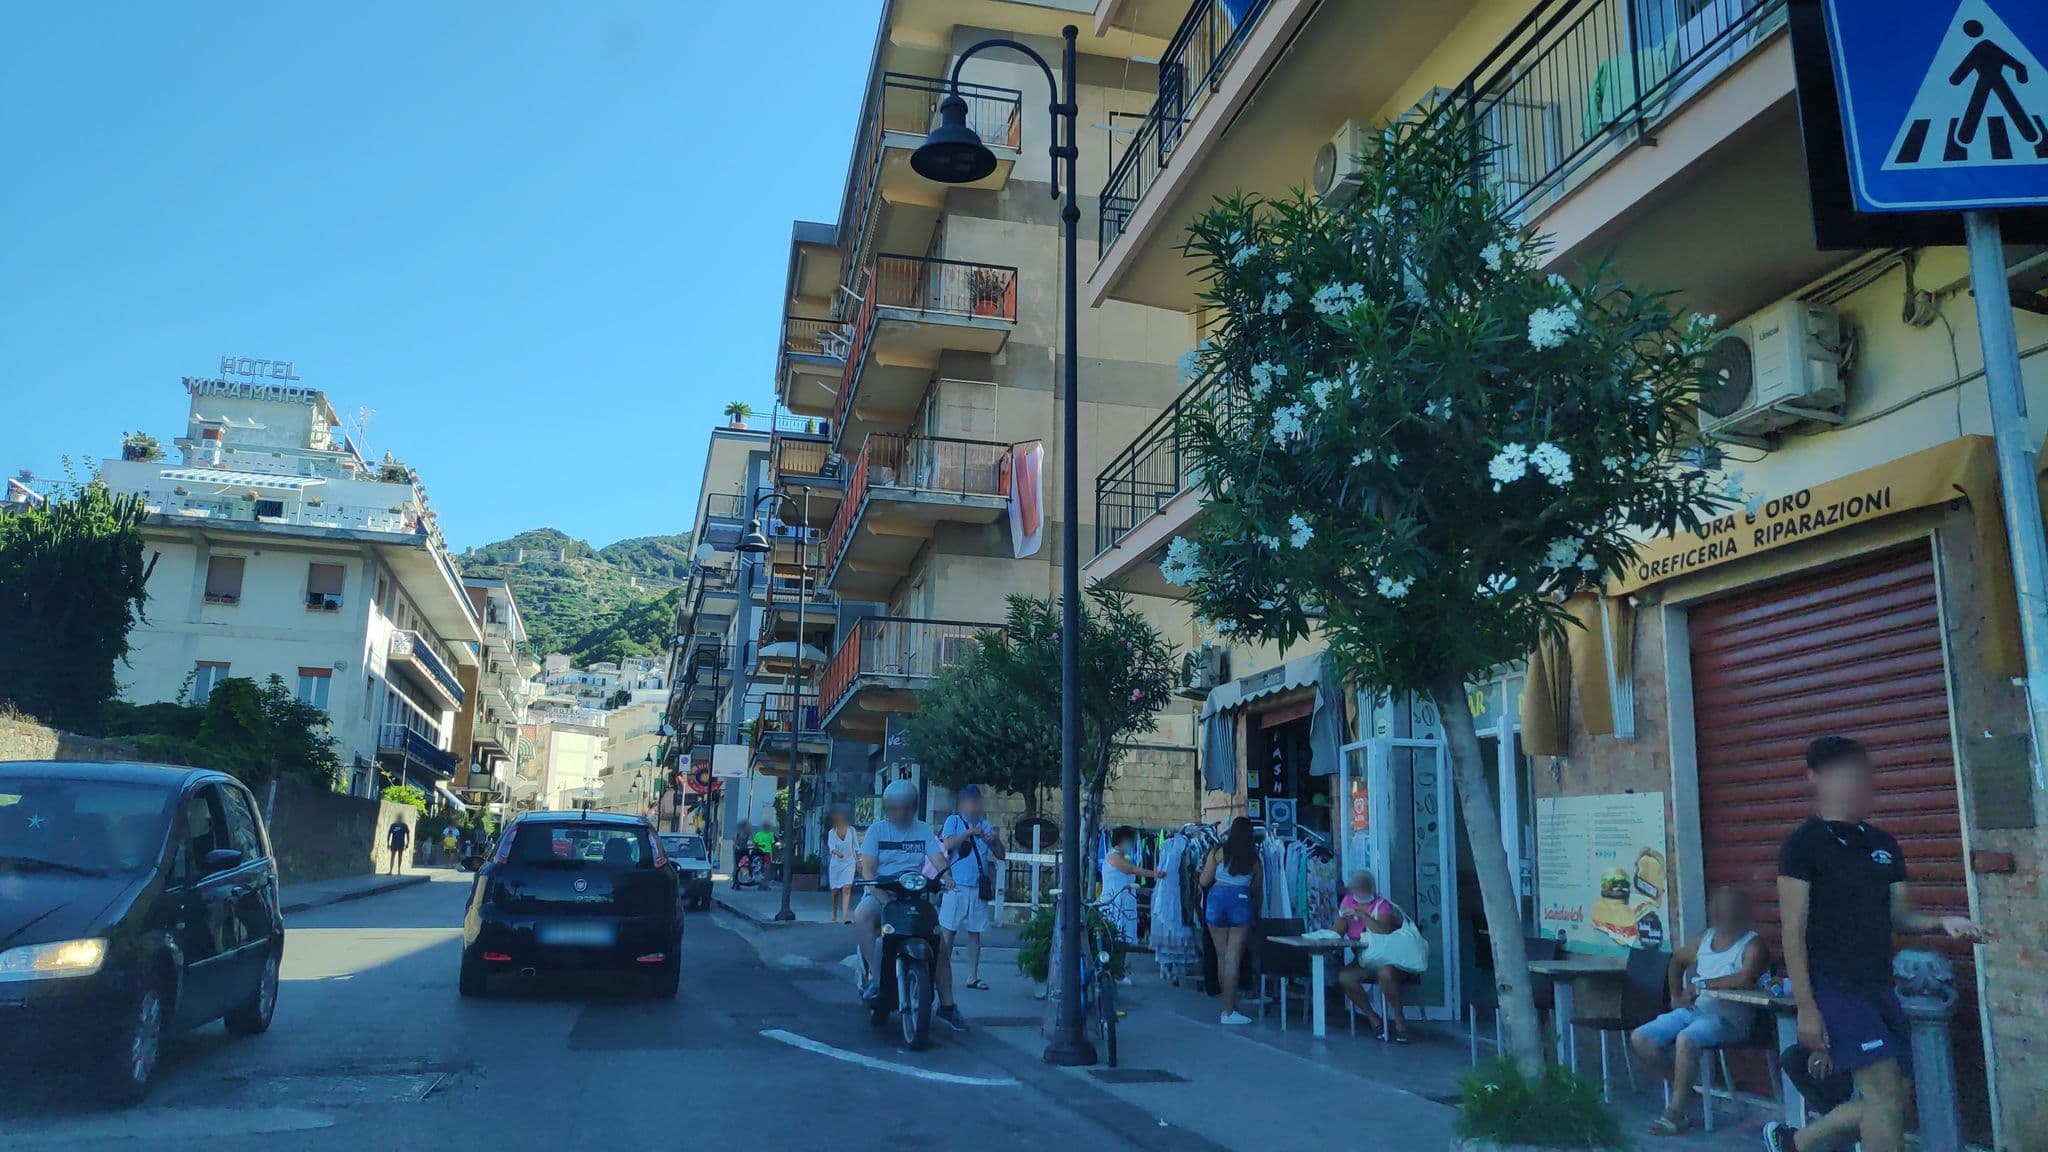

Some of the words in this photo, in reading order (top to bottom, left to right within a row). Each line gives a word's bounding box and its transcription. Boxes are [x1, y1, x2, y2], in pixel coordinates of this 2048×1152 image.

[220, 356, 300, 380] HOTEL
[1766, 488, 1811, 518] ORO
[1639, 537, 1738, 580] OREFICERIA
[1753, 486, 1890, 547] RIPARAZIONI
